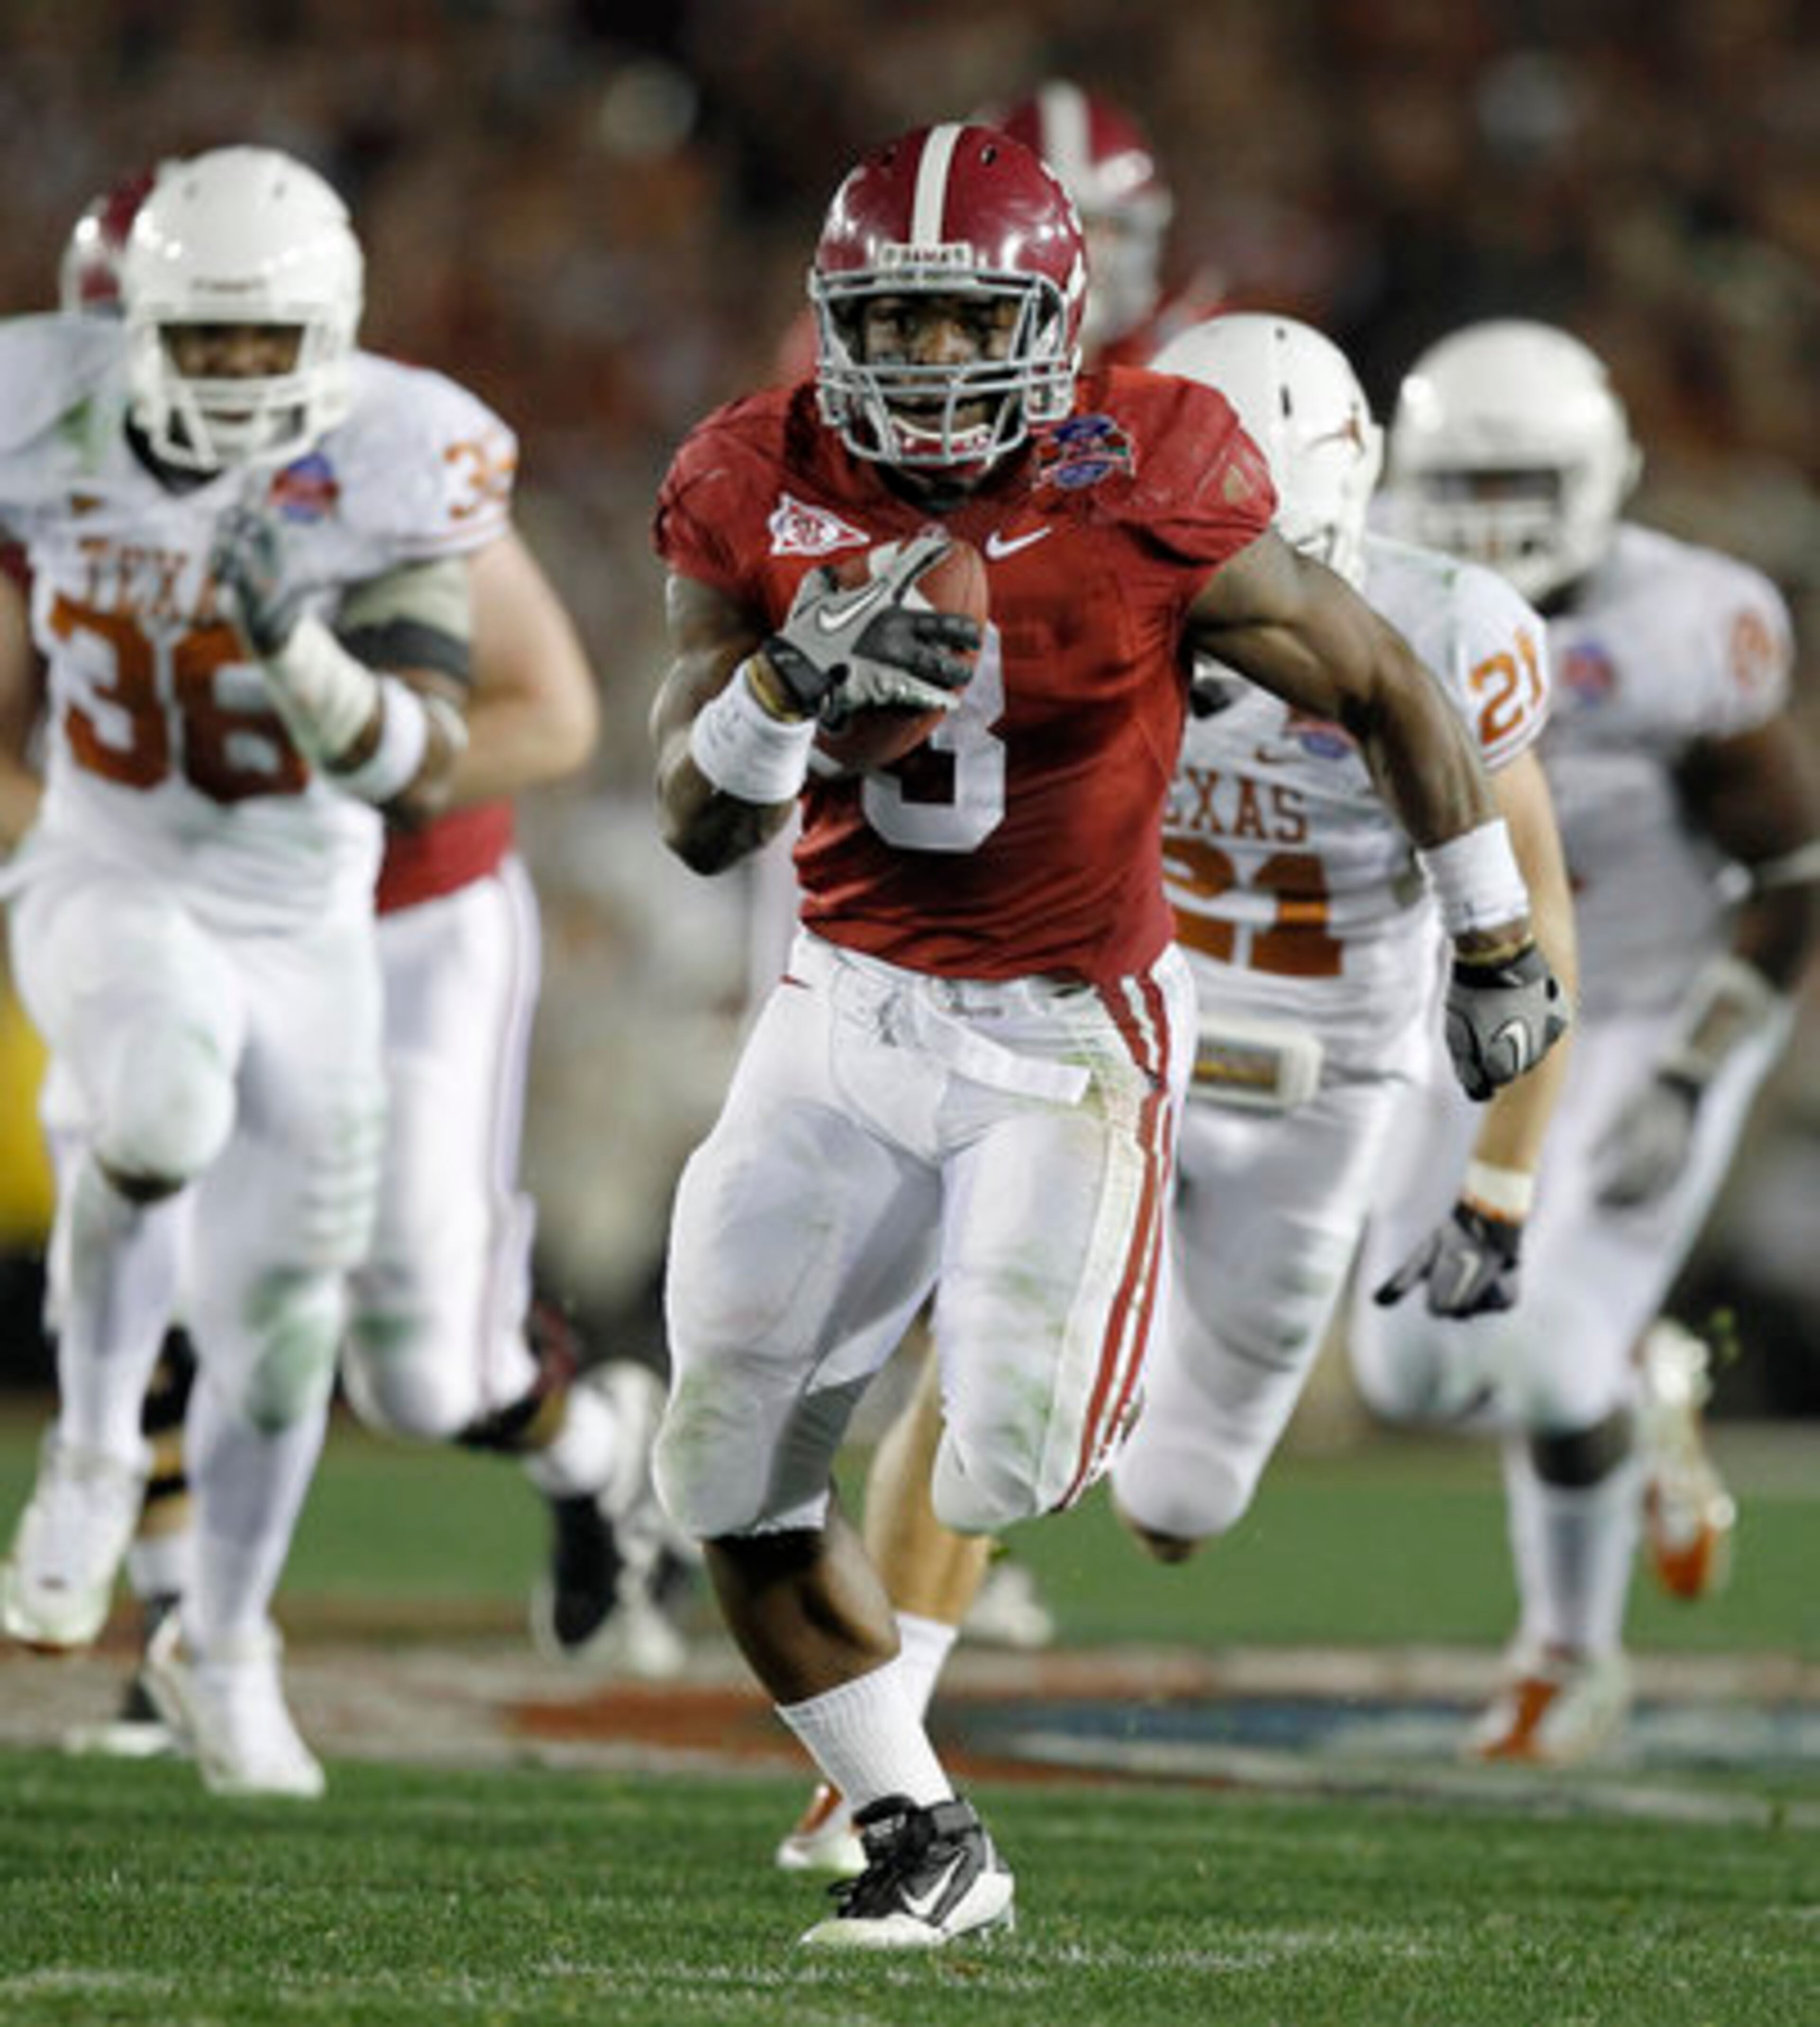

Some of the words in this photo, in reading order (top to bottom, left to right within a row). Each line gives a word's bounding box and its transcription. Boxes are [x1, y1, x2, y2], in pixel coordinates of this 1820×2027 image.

[49, 593, 309, 802] 36
[861, 620, 1006, 852] 3
[1470, 627, 1544, 745] 21
[1161, 835, 1344, 977] 21
